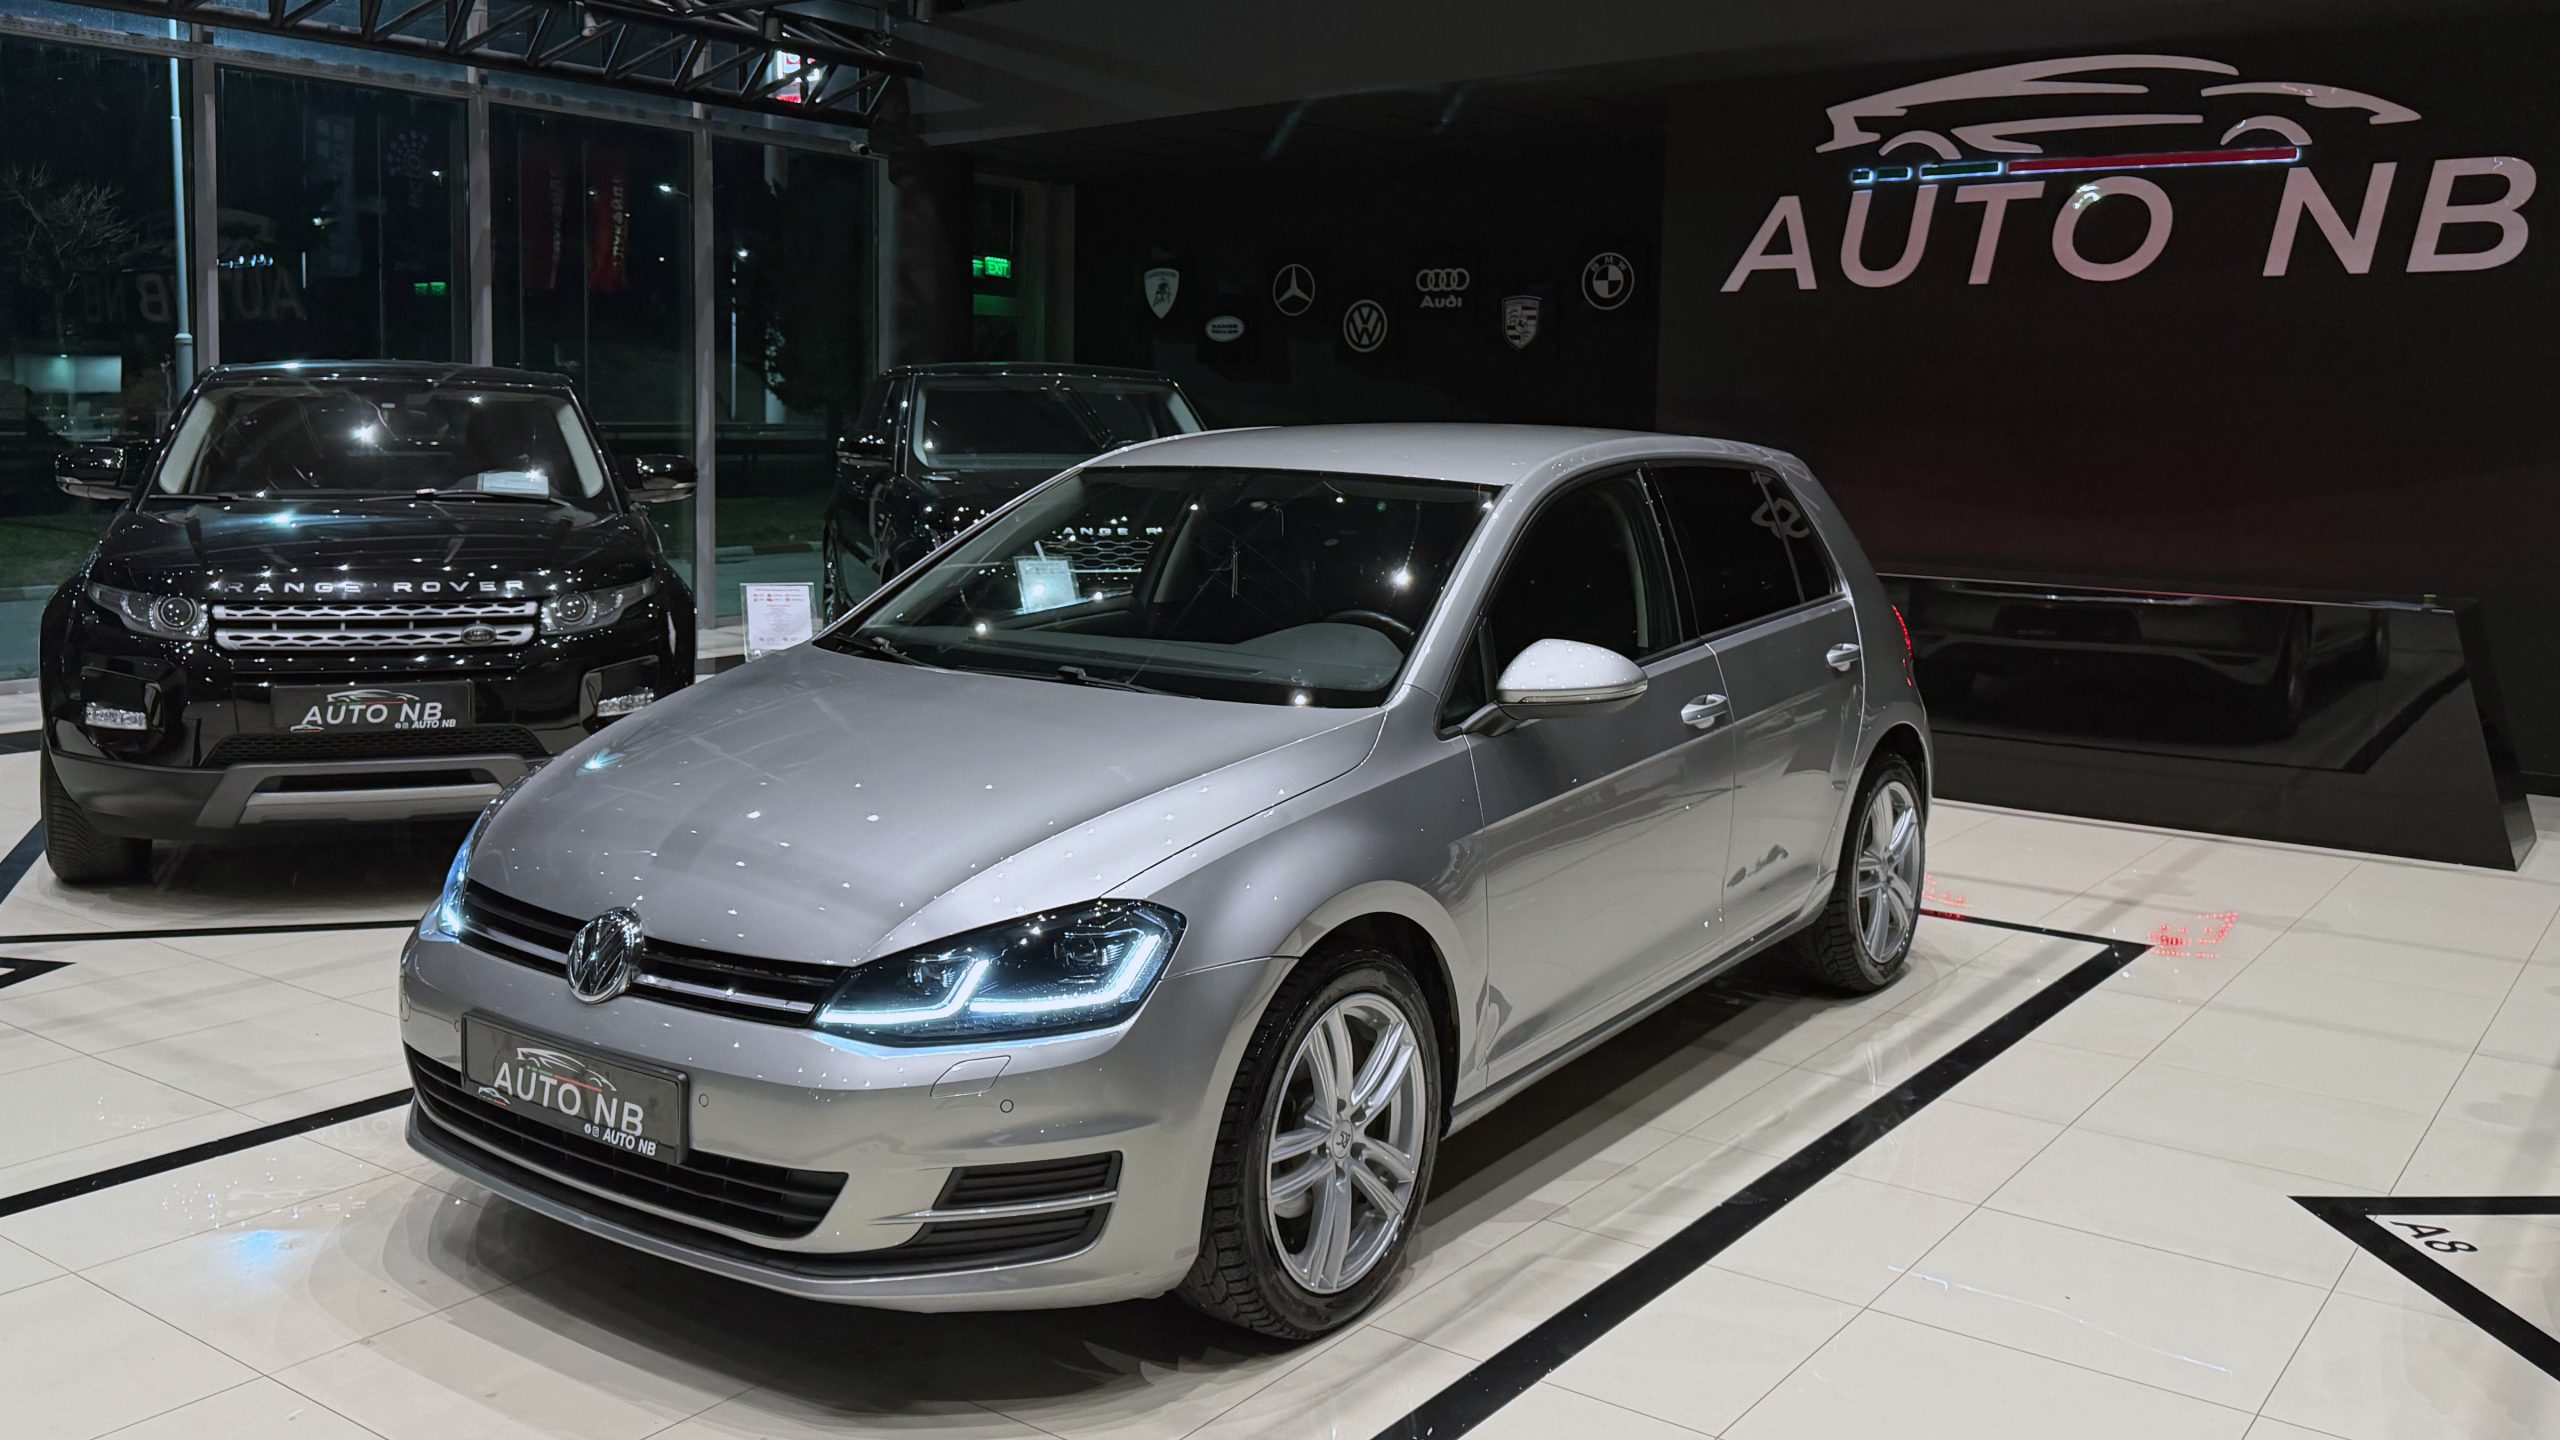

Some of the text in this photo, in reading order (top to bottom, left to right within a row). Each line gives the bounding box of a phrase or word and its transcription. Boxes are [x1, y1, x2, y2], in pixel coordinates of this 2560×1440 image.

[1720, 156, 2538, 292] AUTO NB
[1420, 295, 1462, 308] Audi
[224, 579, 525, 594] RANGE ROVER
[302, 702, 443, 725] AUTO NB
[412, 718, 457, 729] AUTO NB
[493, 1062, 644, 1137] AUTO NB
[602, 1128, 657, 1156] AUTO NB
[2389, 1221, 2479, 1253] A8
